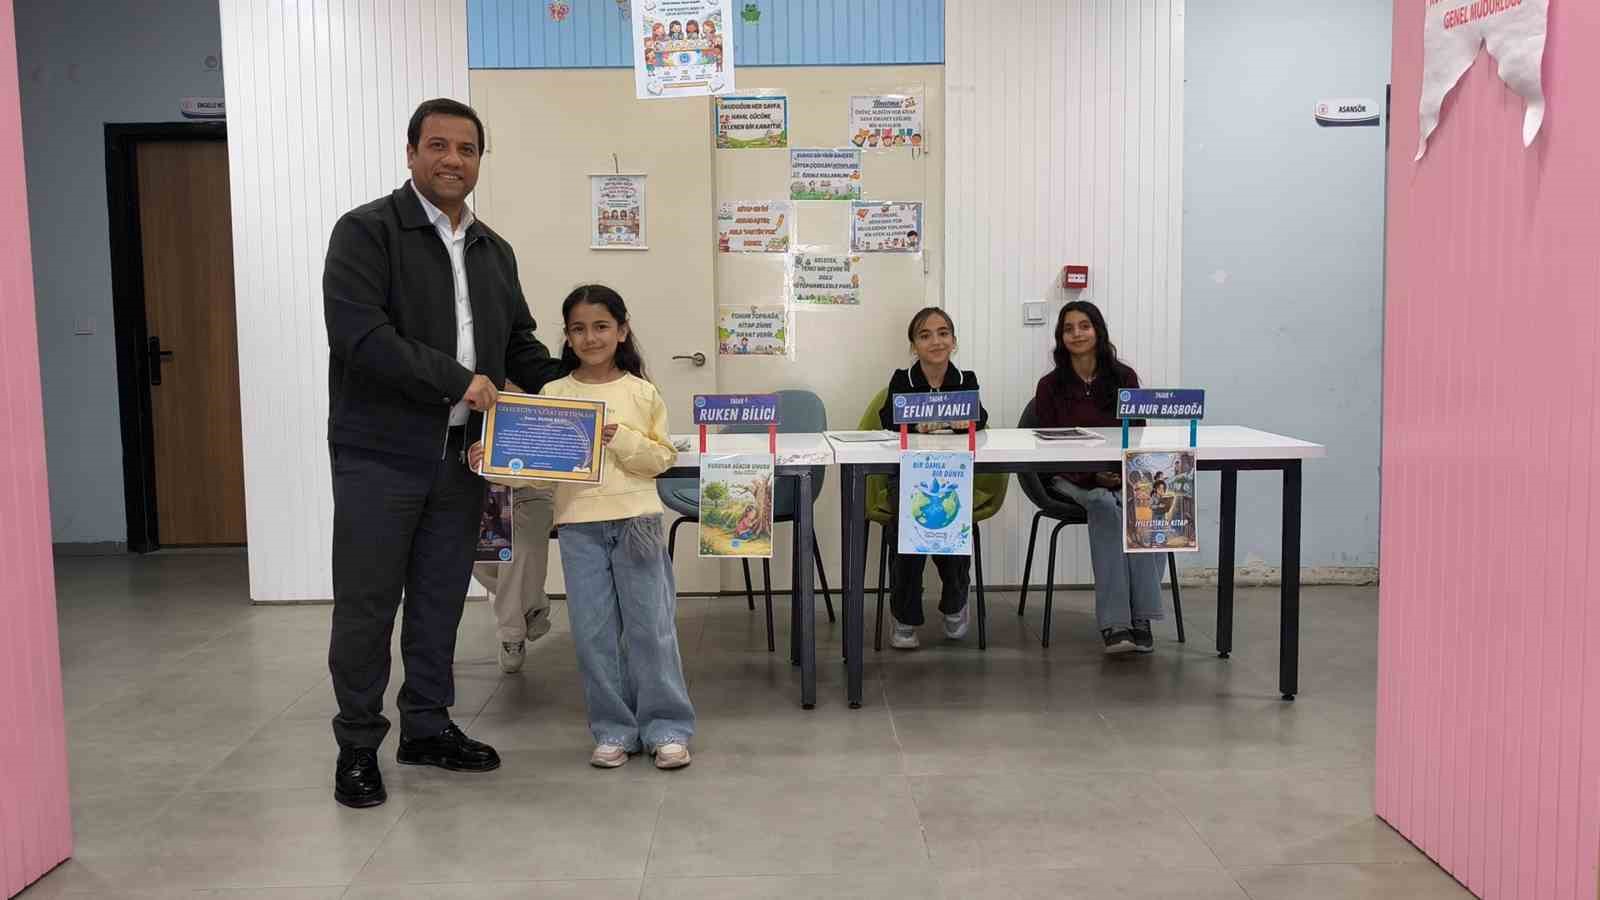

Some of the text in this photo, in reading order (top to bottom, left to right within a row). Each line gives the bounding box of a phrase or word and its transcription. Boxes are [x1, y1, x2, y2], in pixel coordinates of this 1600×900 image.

[1470, 0, 1521, 18] MÜDÜRLÜ
[1338, 104, 1367, 113] ASANSÖR
[699, 404, 776, 421] RUKEN BİLİCİ
[903, 402, 934, 418] EFLİN
[1120, 402, 1202, 417] ELA NUR BAŞBOĞA
